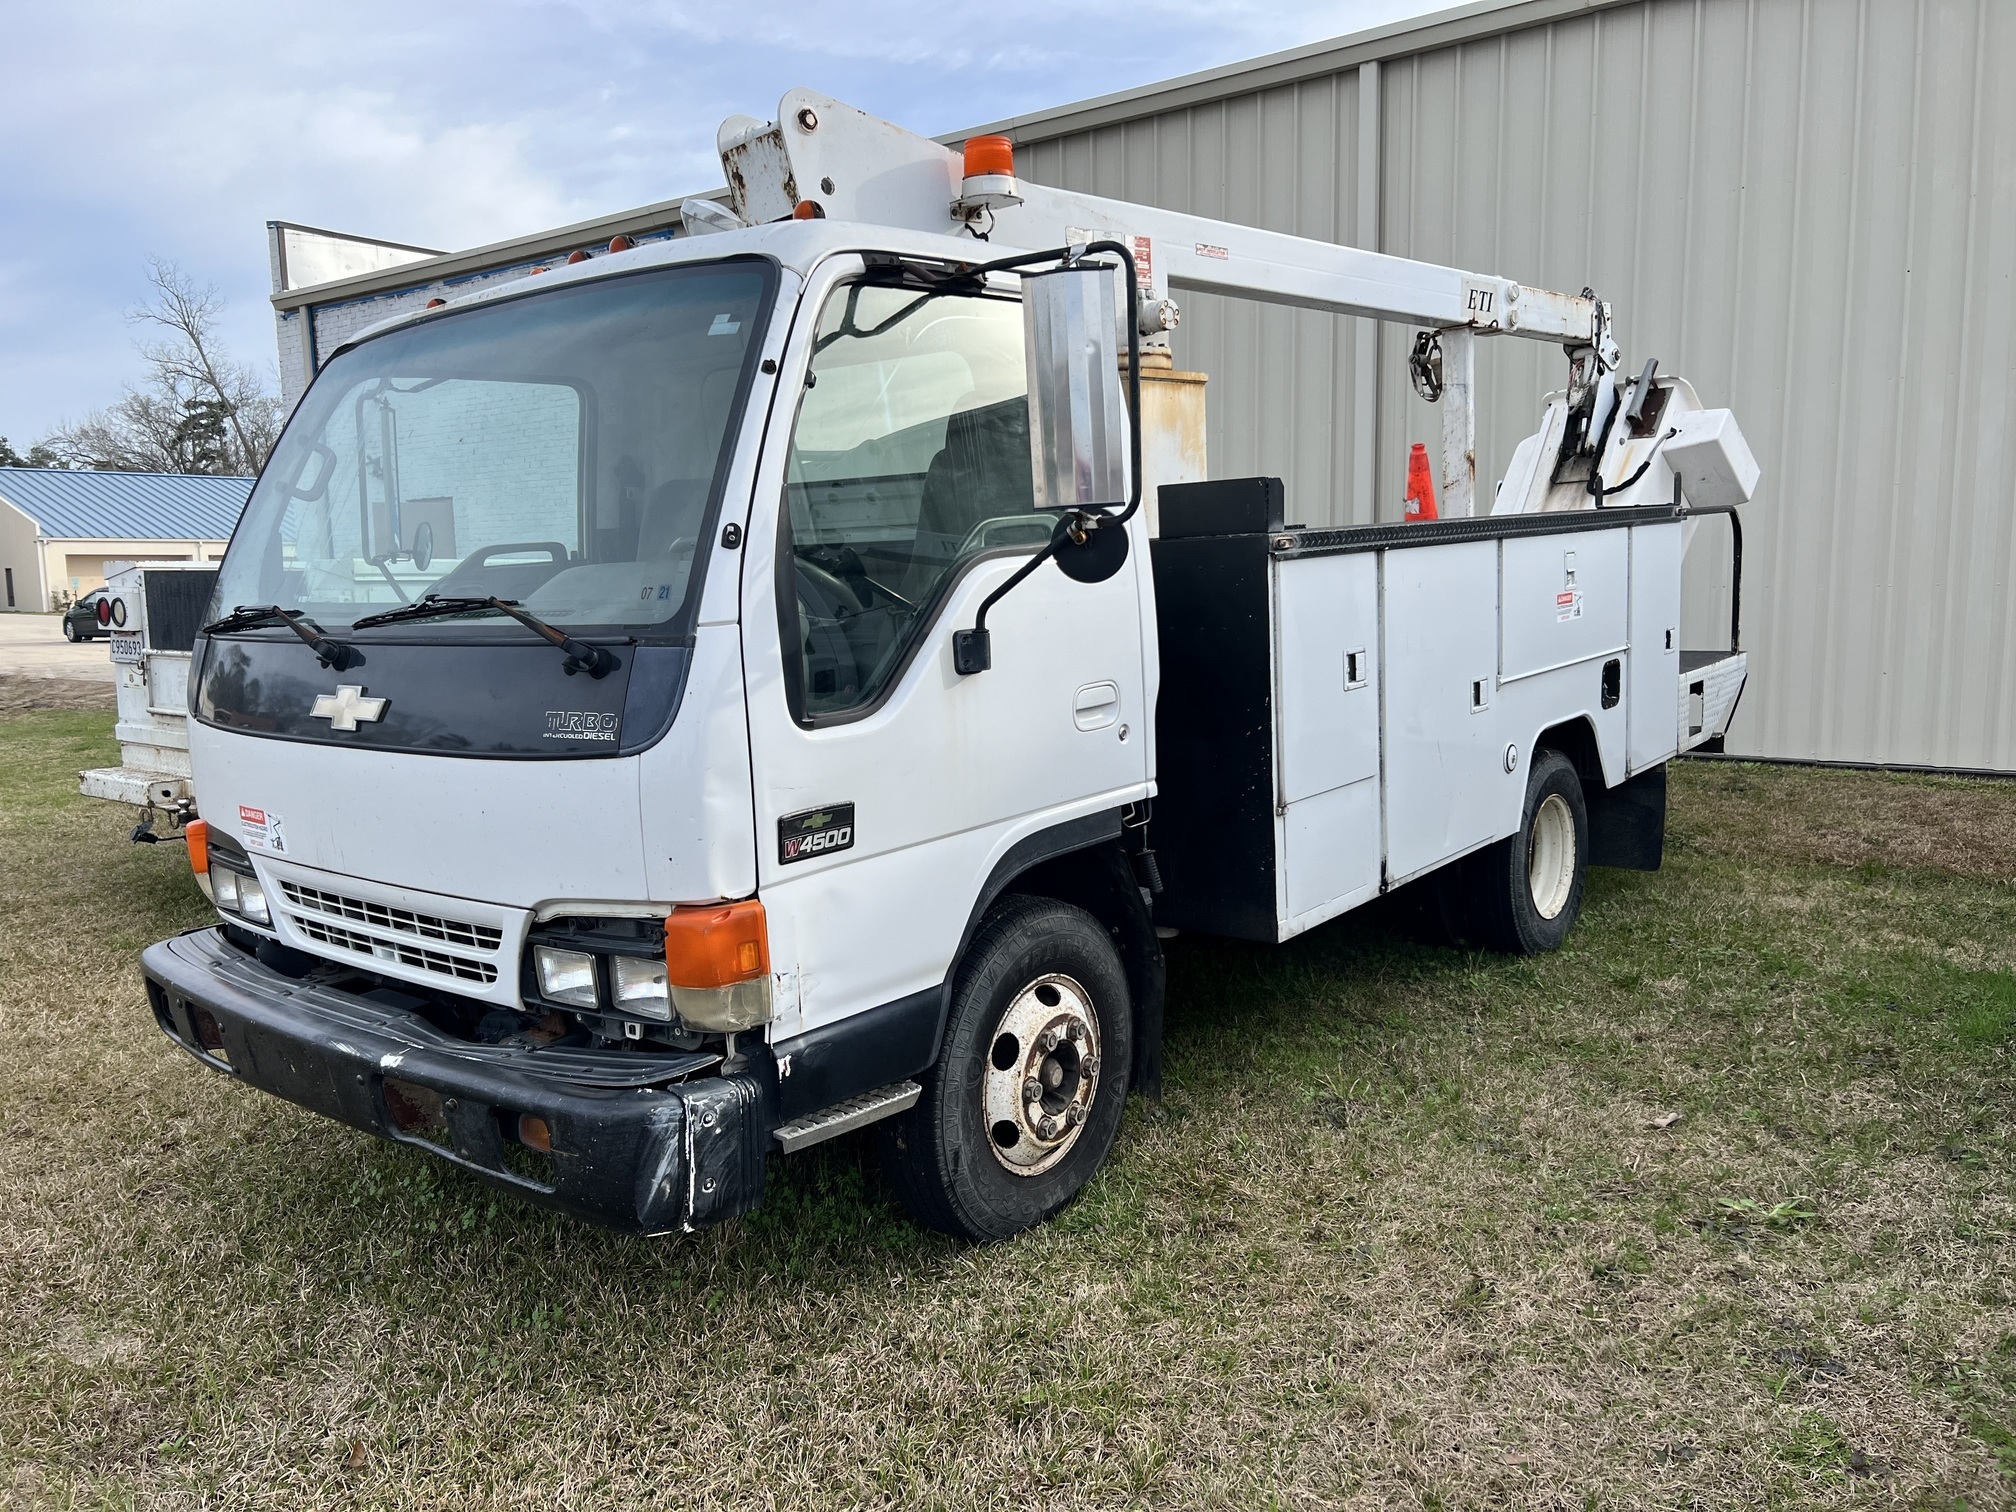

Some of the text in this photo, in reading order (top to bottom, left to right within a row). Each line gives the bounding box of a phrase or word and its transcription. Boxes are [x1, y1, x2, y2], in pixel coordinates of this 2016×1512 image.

[1467, 288, 1494, 312] ETI
[641, 587, 654, 600] 07
[659, 586, 670, 599] 21
[111, 639, 142, 656] C950693
[545, 711, 619, 733] TURBO
[583, 732, 616, 741] DIESEL
[784, 827, 852, 859] W4500
